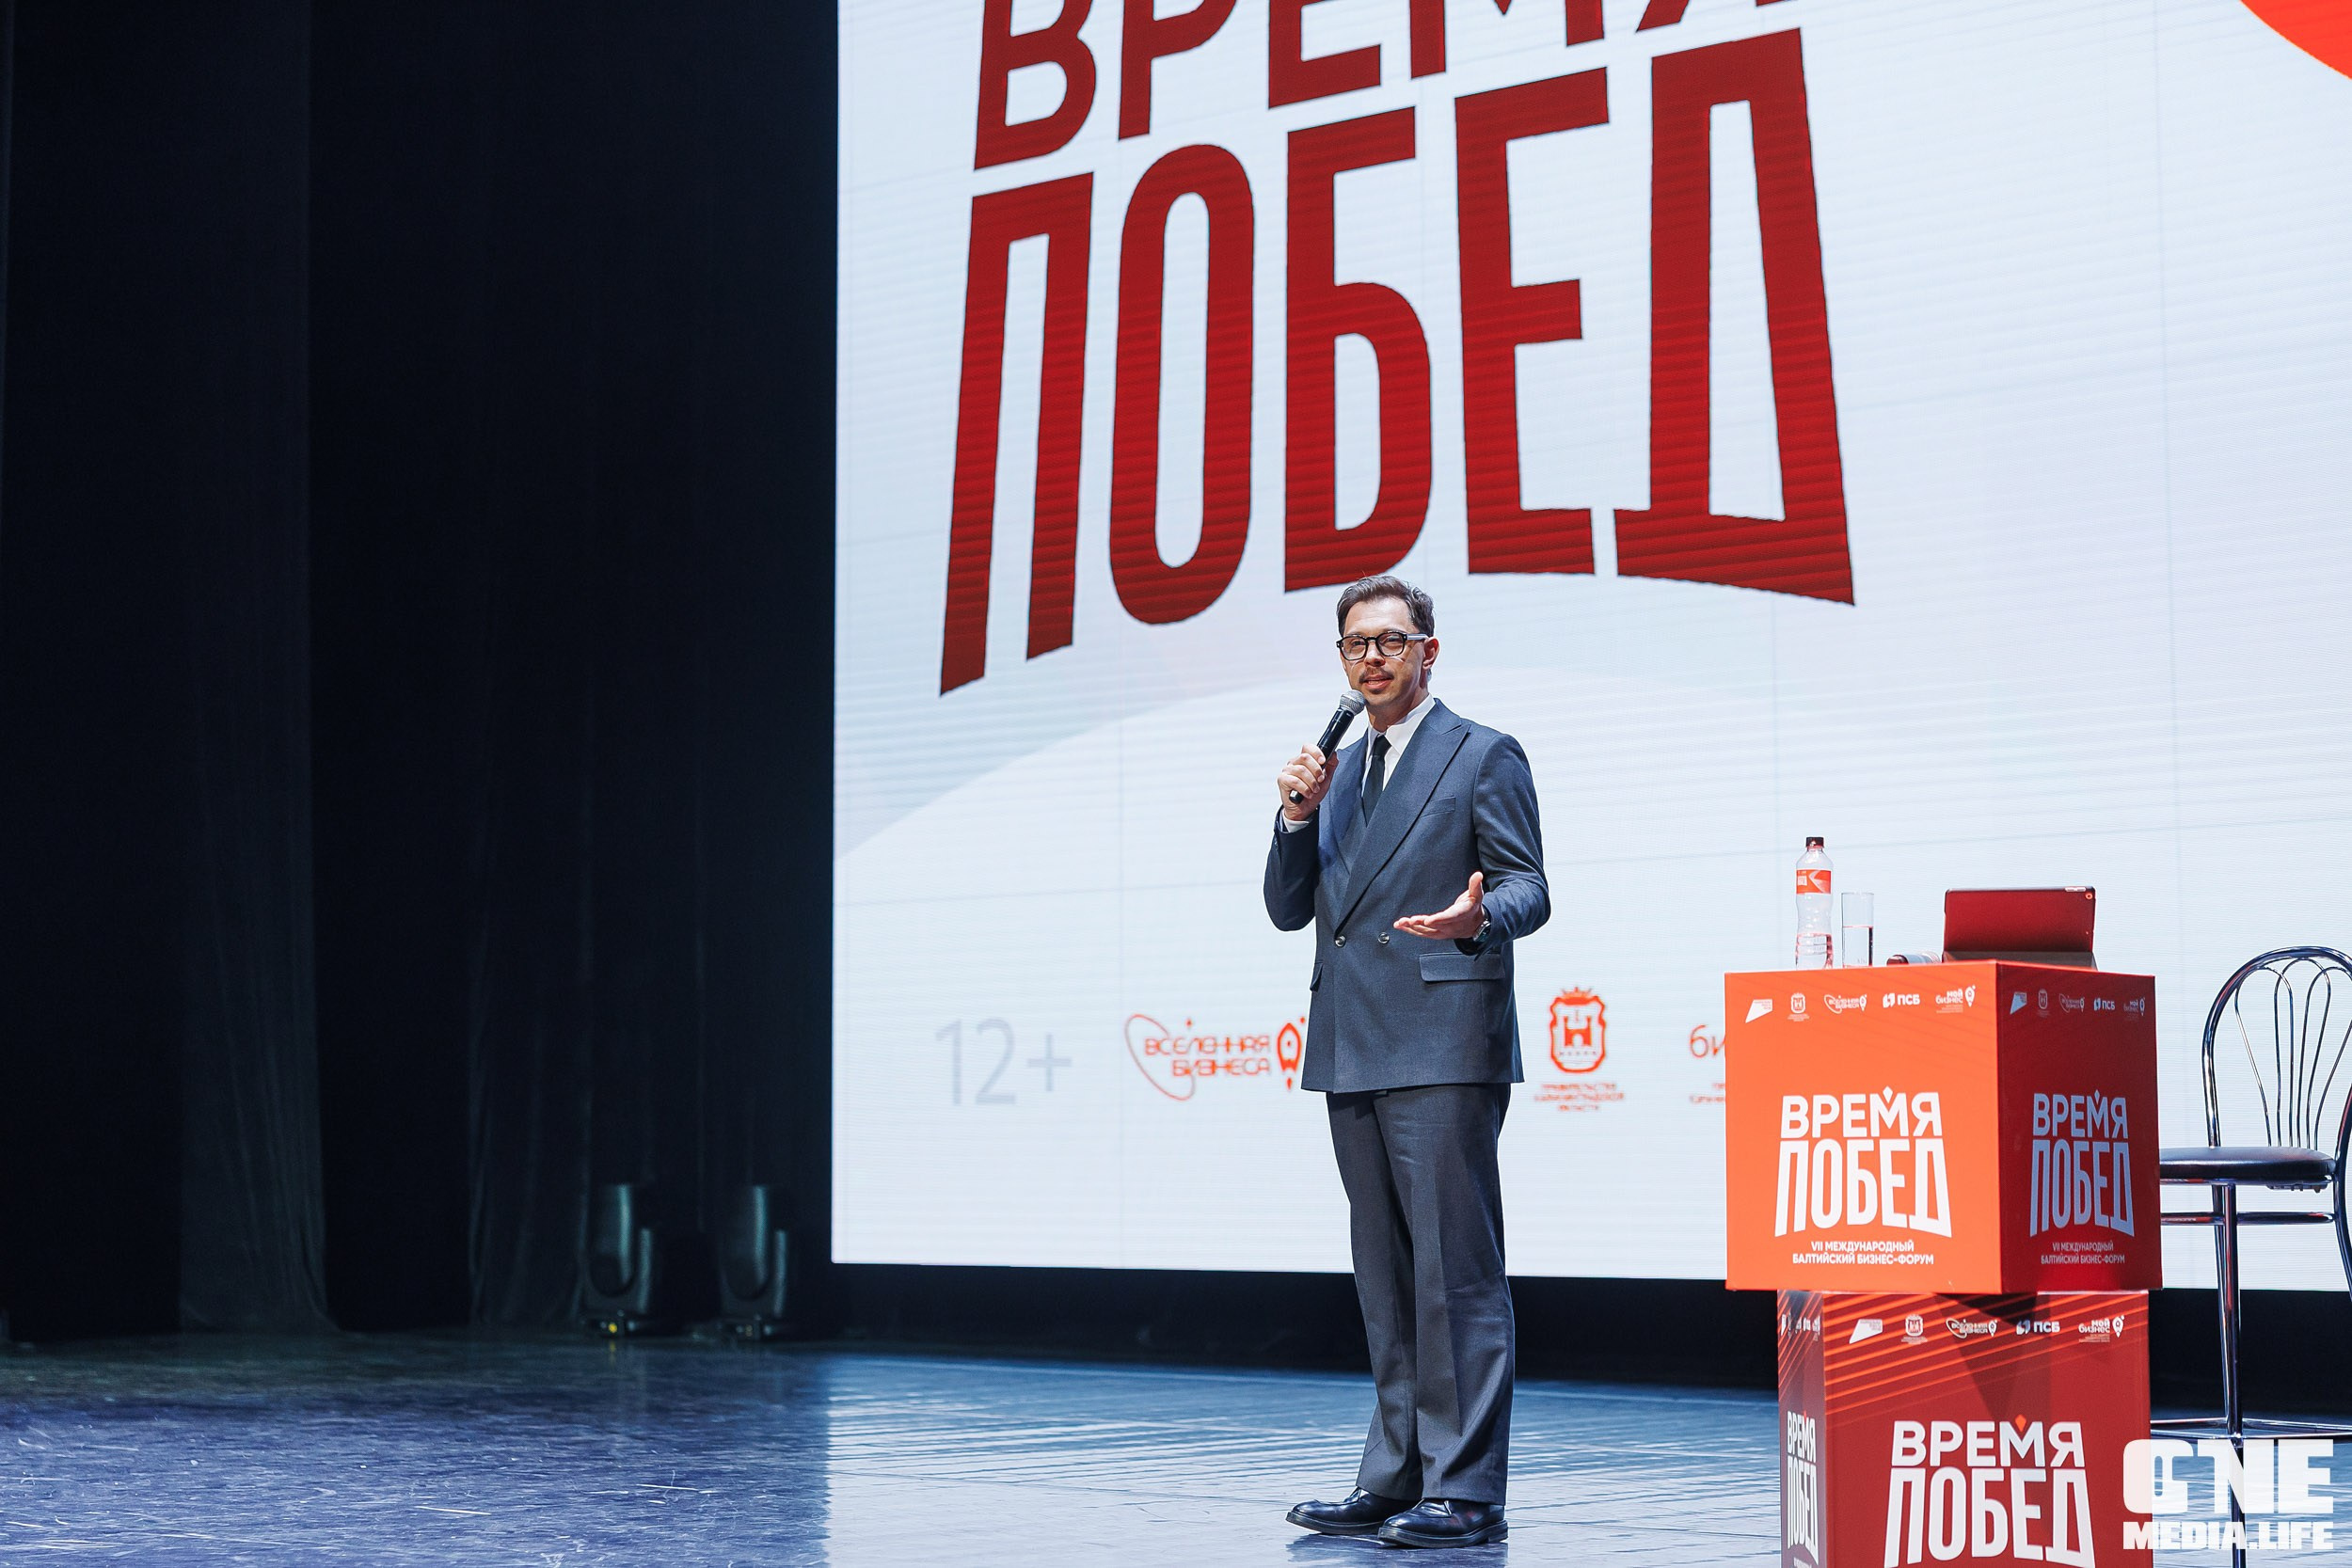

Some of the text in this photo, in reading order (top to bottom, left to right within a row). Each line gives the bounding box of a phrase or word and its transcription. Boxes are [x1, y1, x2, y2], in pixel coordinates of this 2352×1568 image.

[940, 27, 1855, 696] ПОБЕД
[1897, 994, 1920, 1006] ПСБ
[935, 1018, 1073, 1106] 12+
[1780, 1090, 1944, 1139] ВРЕМЯ
[2033, 1092, 2129, 1139] ВРЕМЯ
[1774, 1137, 1953, 1238] ПОБЕД
[2029, 1138, 2136, 1238] ПОБЕД
[1792, 1252, 1934, 1265] БАЛТИЙСКИЙ БИЗНЕС-ФОРУМ
[1811, 1239, 1915, 1253] VII МЕЖДУНАРОДНЫЙ
[2041, 1252, 2125, 1265] БАЛТИЙСКИЙ БИЗНЕС-ФОРУМ
[2061, 1240, 2114, 1253] МЕЖДУНАРОДНЫЙ
[2033, 1321, 2060, 1333] ПСБ
[1788, 1410, 1817, 1464] ВРЕМЯ
[1891, 1420, 2086, 1468] ВРЕМЯ
[1788, 1454, 1820, 1565] ПОБЕД
[1883, 1466, 2096, 1568] ПОБЕД
